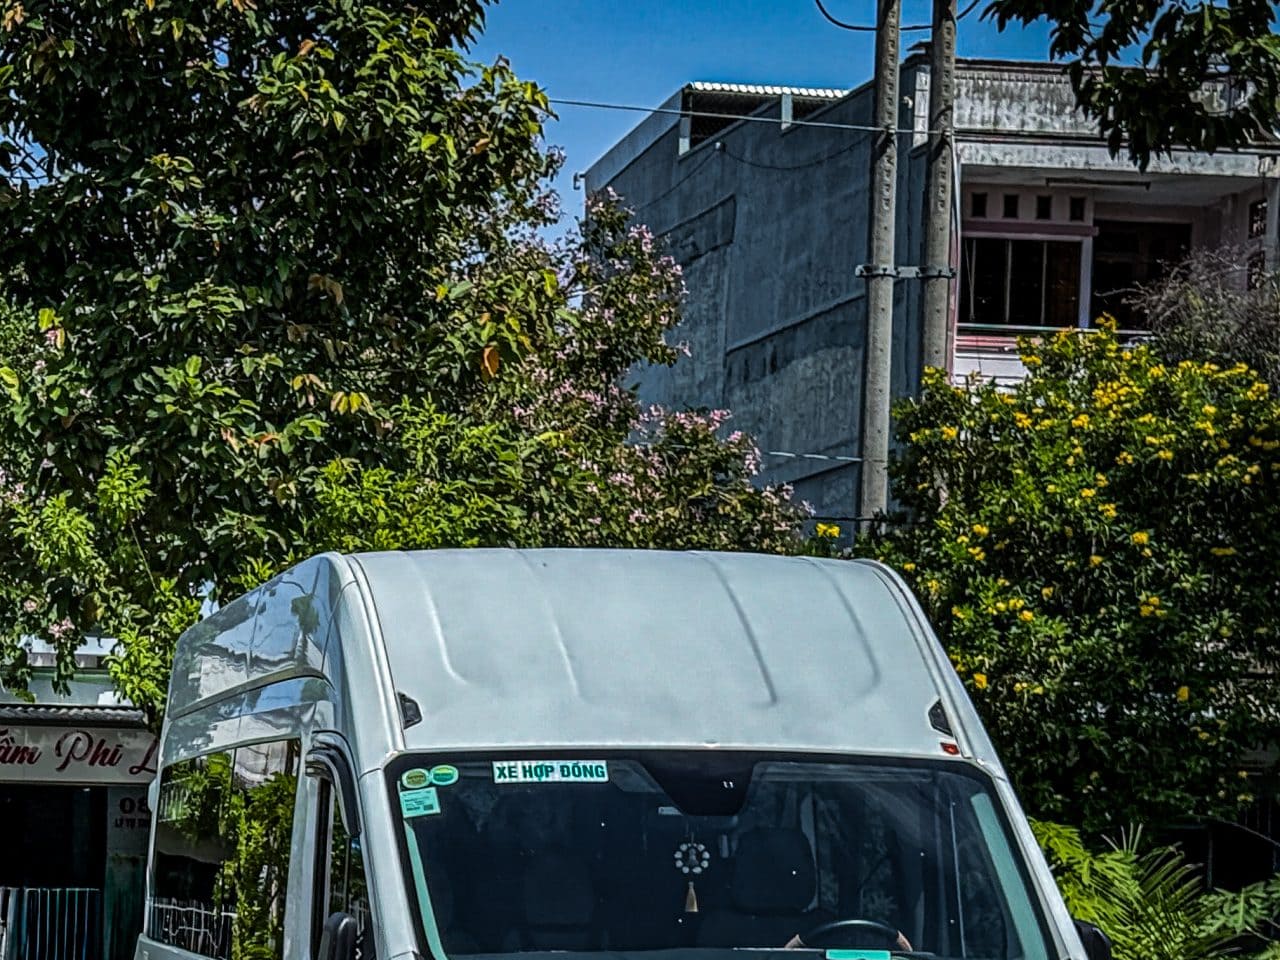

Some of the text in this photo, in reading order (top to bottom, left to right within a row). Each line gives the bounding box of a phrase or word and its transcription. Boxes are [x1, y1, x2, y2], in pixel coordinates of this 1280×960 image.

[55, 730, 122, 771] Phi
[128, 737, 159, 775] L
[496, 765, 518, 779] XE
